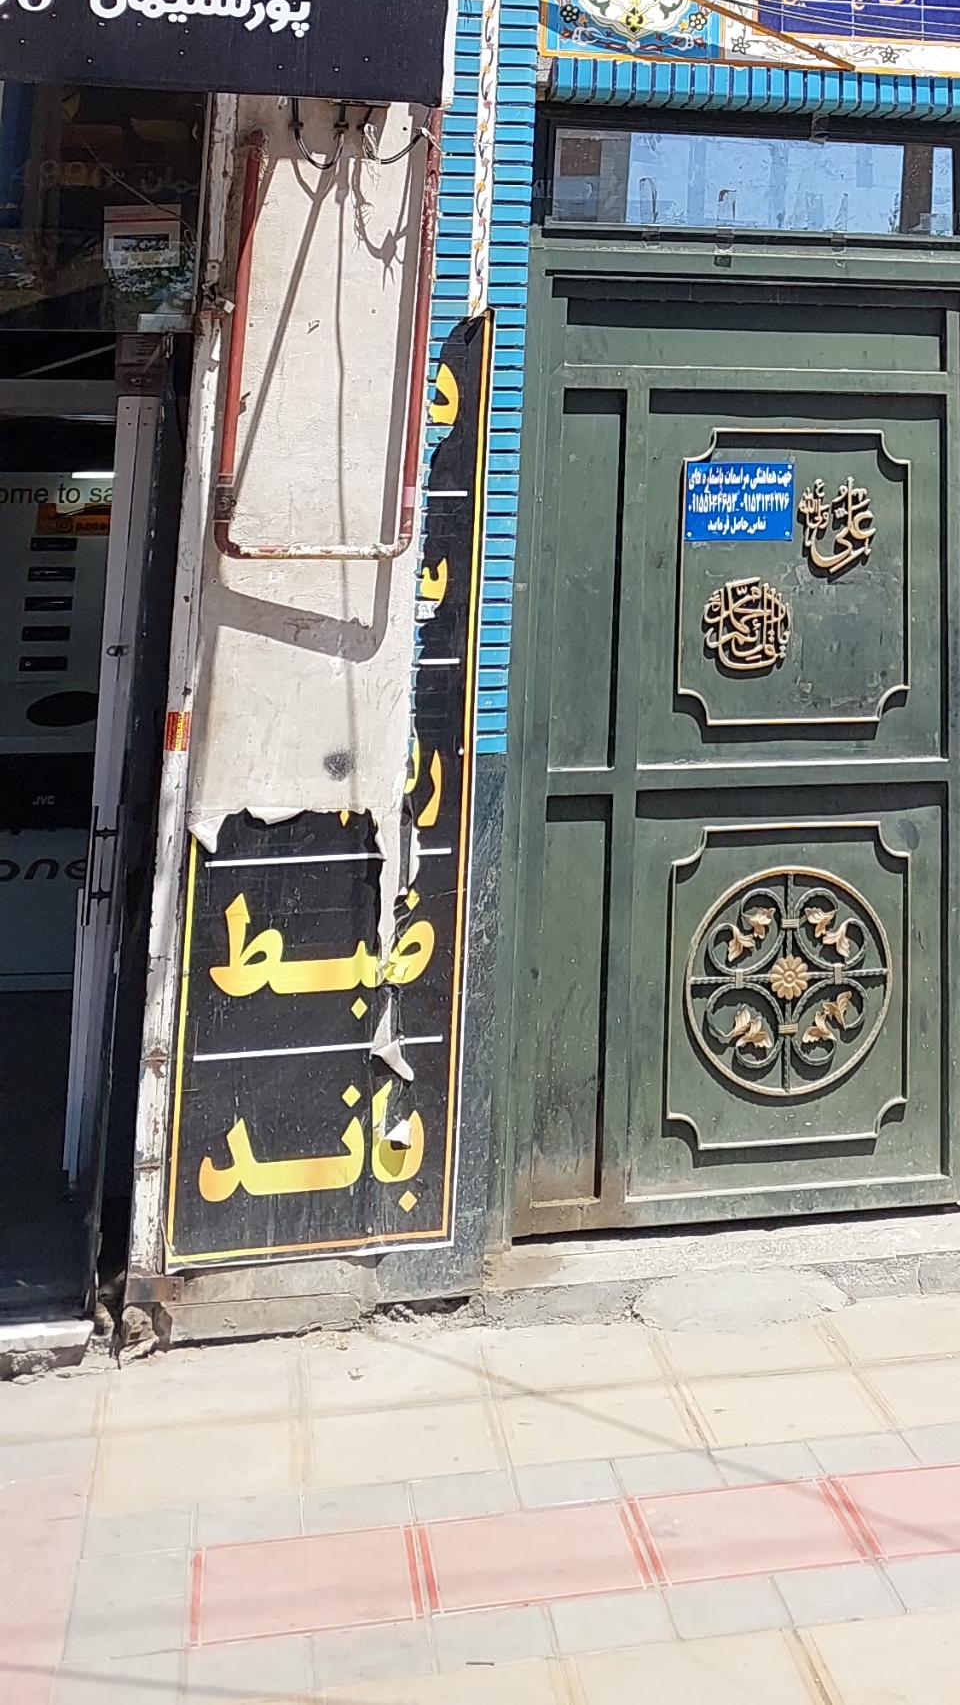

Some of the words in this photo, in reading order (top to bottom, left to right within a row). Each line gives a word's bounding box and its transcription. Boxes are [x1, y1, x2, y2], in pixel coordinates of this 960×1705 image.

[57, 483, 81, 504] to
[32, 795, 56, 806] JVC
[209, 888, 435, 1020] ضبط
